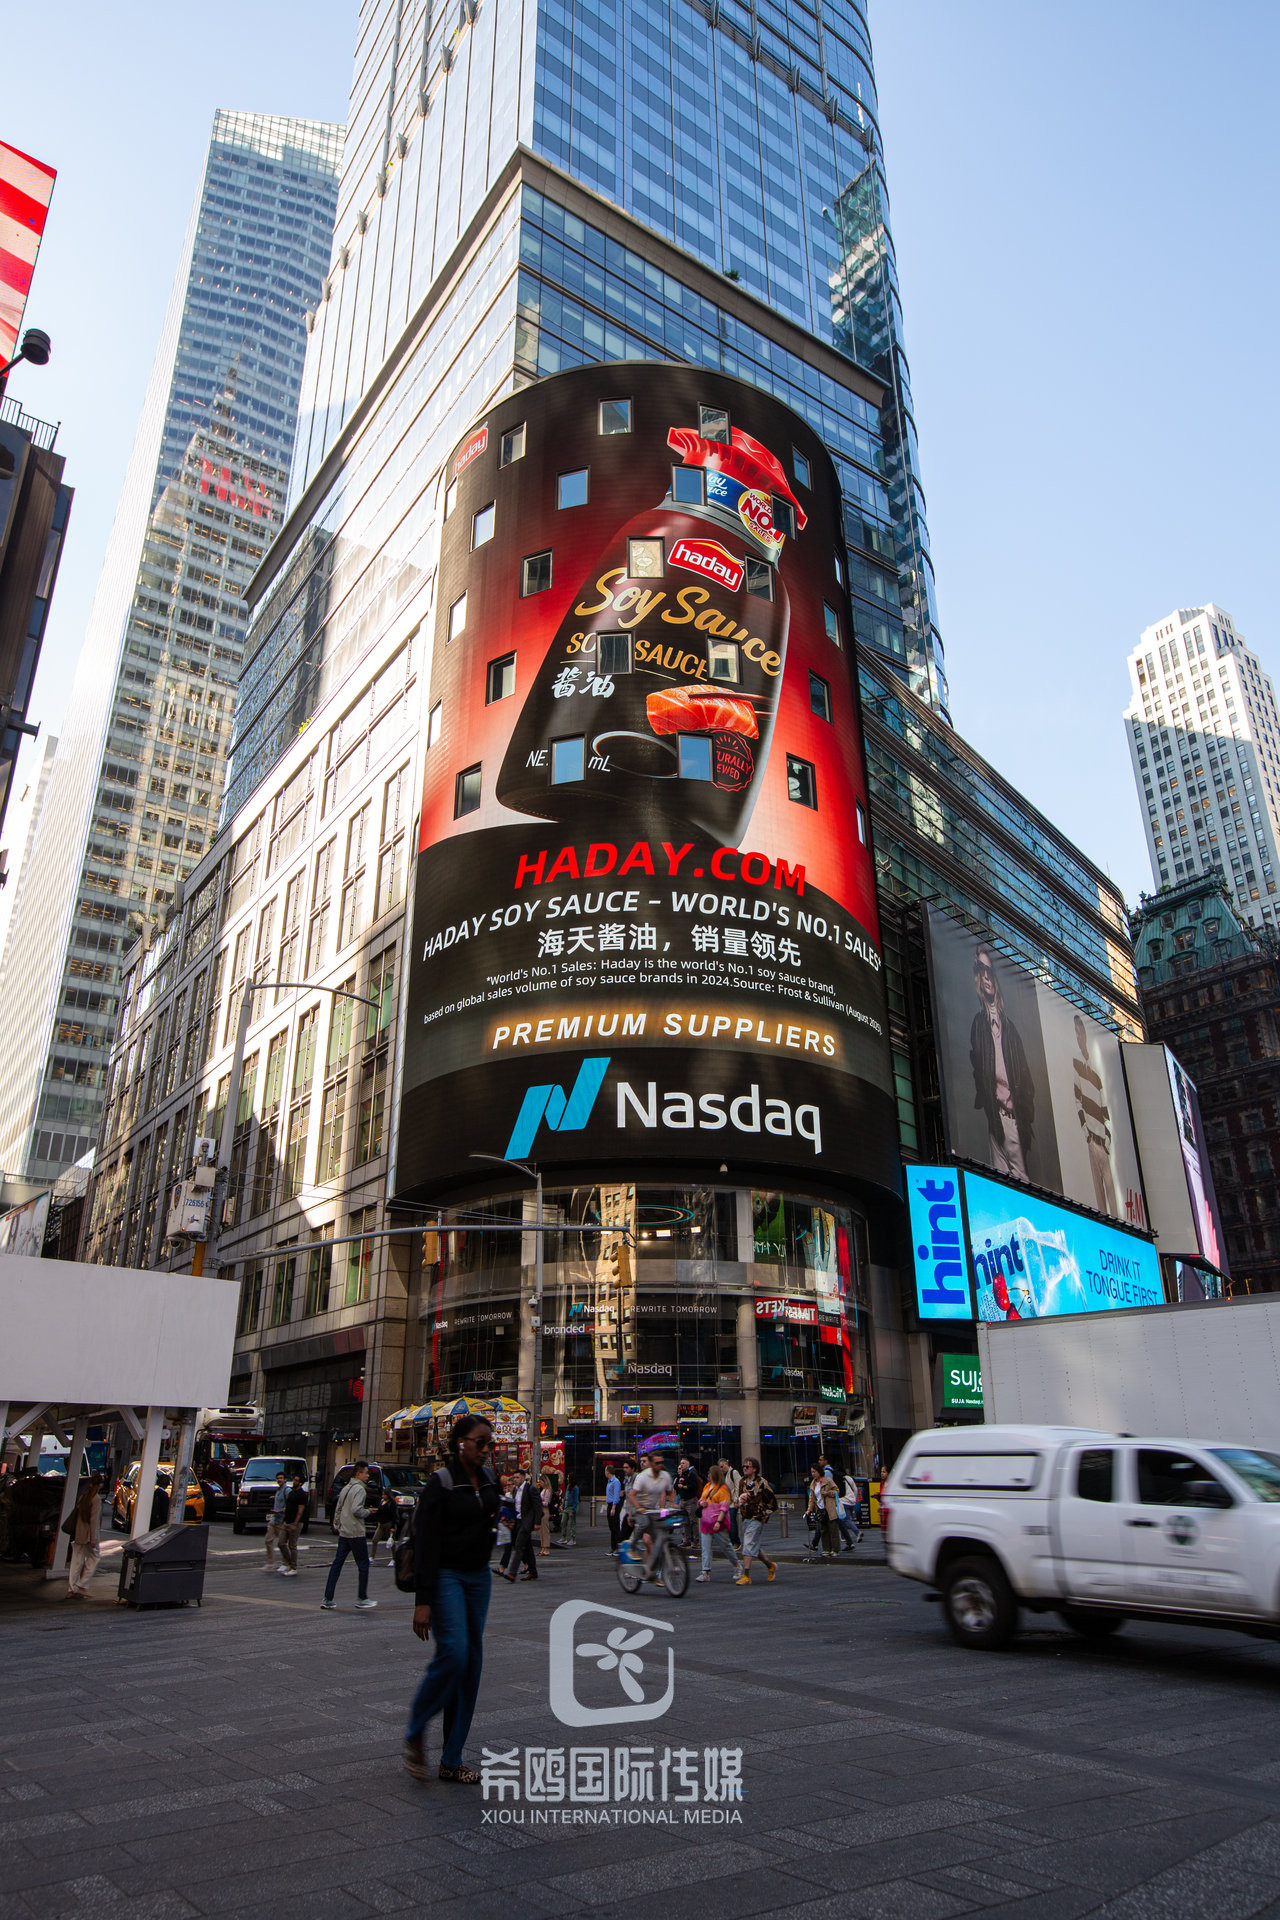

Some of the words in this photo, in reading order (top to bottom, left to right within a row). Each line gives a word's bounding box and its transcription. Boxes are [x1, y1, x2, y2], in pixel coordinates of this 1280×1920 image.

[455, 436, 485, 475] haday
[749, 521, 772, 545] SALES
[675, 544, 738, 586] haday
[574, 567, 666, 628] Soy
[661, 586, 781, 677] Sauce
[566, 632, 597, 654] SO
[635, 640, 707, 682] SAUCE
[588, 755, 611, 772] mL
[514, 842, 806, 897] HADAY.COM
[423, 914, 486, 962] HADAY
[489, 900, 544, 931] SOY
[546, 891, 640, 919] SAUCE
[671, 891, 790, 927] WORLD'S
[797, 911, 840, 945] NO.1
[531, 965, 557, 979] No.1
[561, 961, 597, 974] Sales:
[601, 959, 641, 971] Haday
[645, 958, 654, 969] is
[657, 958, 677, 969] the
[681, 960, 725, 974] world's
[728, 963, 753, 976] No.1
[757, 967, 775, 981] soy
[778, 971, 807, 986] sauce
[808, 977, 837, 997] brand,
[424, 1006, 443, 1025] based
[444, 1003, 455, 1014] on
[457, 991, 485, 1012] global
[487, 986, 513, 1001] sales
[515, 980, 558, 996] volume
[560, 975, 573, 988] of
[576, 976, 597, 989] soy
[600, 974, 636, 986] sauce
[639, 972, 683, 984] brands
[686, 973, 697, 984] in
[778, 984, 802, 1000] Frost
[804, 990, 812, 1003] &
[813, 992, 845, 1014] Sullivan
[492, 1013, 647, 1050] PREMIUM
[663, 1013, 836, 1057] SUPPLIERS
[616, 1081, 822, 1155] Nasdaq
[1125, 1187, 1145, 1228] H&M
[917, 1179, 966, 1305] hint
[1099, 1249, 1132, 1279] DRINK
[1132, 1260, 1141, 1282] IT
[1086, 1270, 1132, 1303] TONGUE
[1132, 1284, 1158, 1306] FIRST
[477, 1311, 513, 1322] TOMORROW
[583, 1305, 615, 1315] Nasdaq
[630, 1305, 667, 1313] REWRITE
[670, 1305, 718, 1313] TOMORROW
[628, 1363, 673, 1377] Nasdaq
